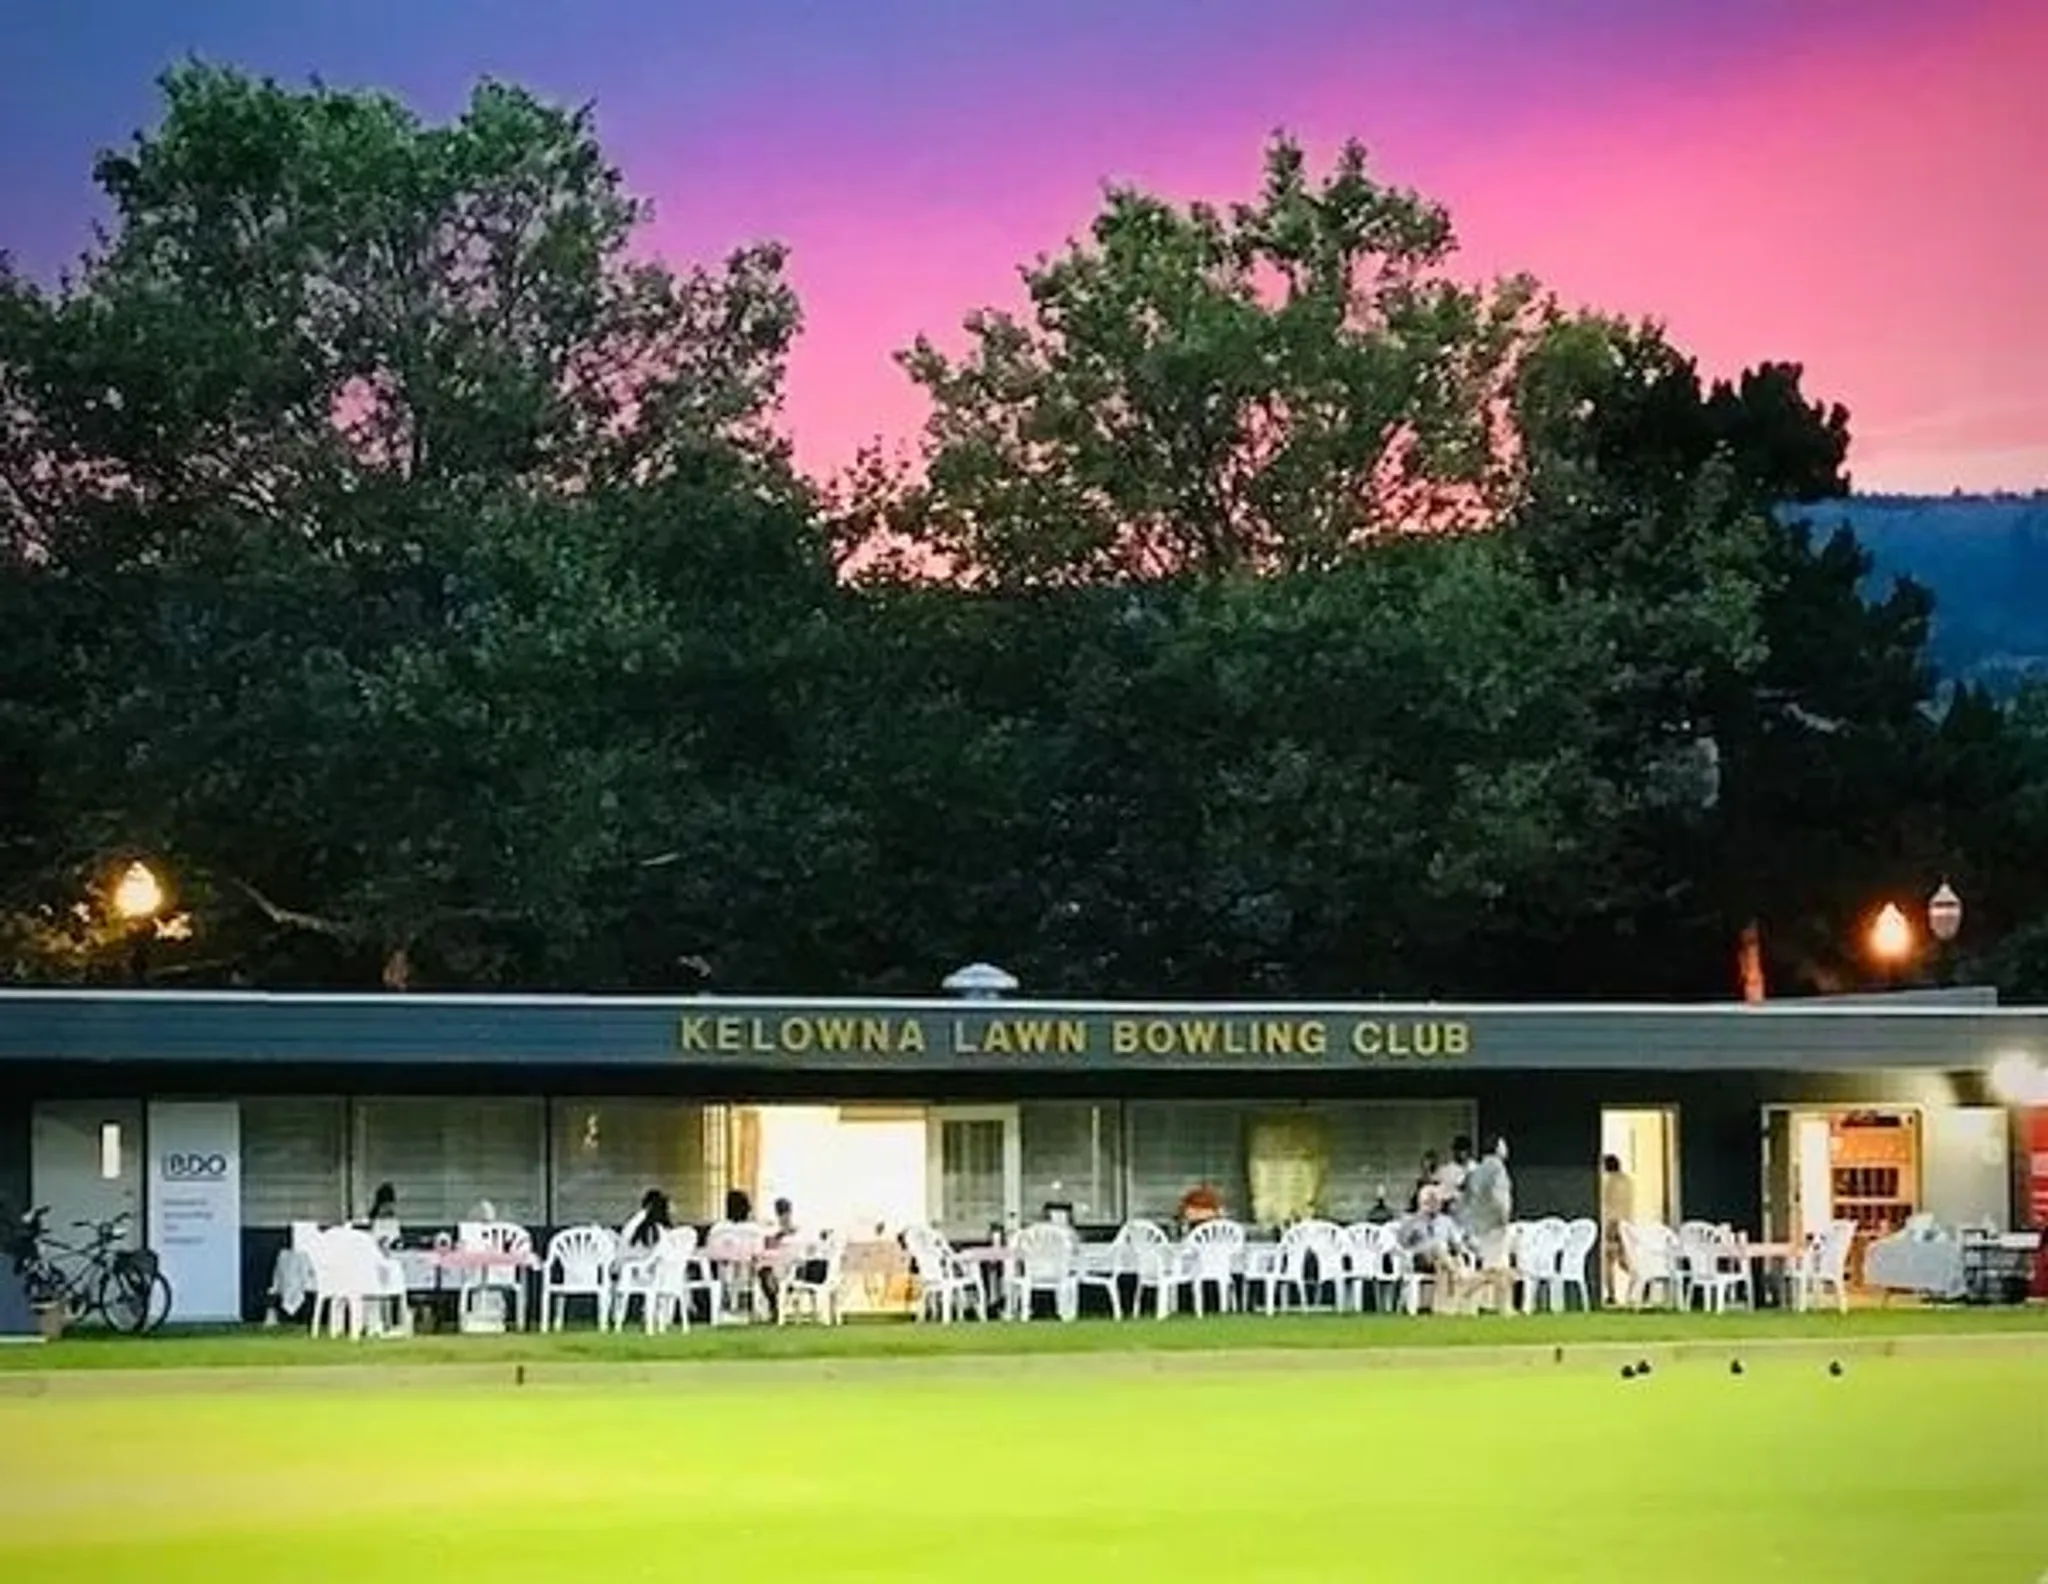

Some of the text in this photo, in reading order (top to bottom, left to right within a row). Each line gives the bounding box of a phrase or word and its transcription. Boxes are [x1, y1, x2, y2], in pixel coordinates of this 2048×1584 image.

[681, 1017, 1471, 1055] KELOWNA LAWN BOWLING CLUB
[170, 1153, 227, 1174] BDO
